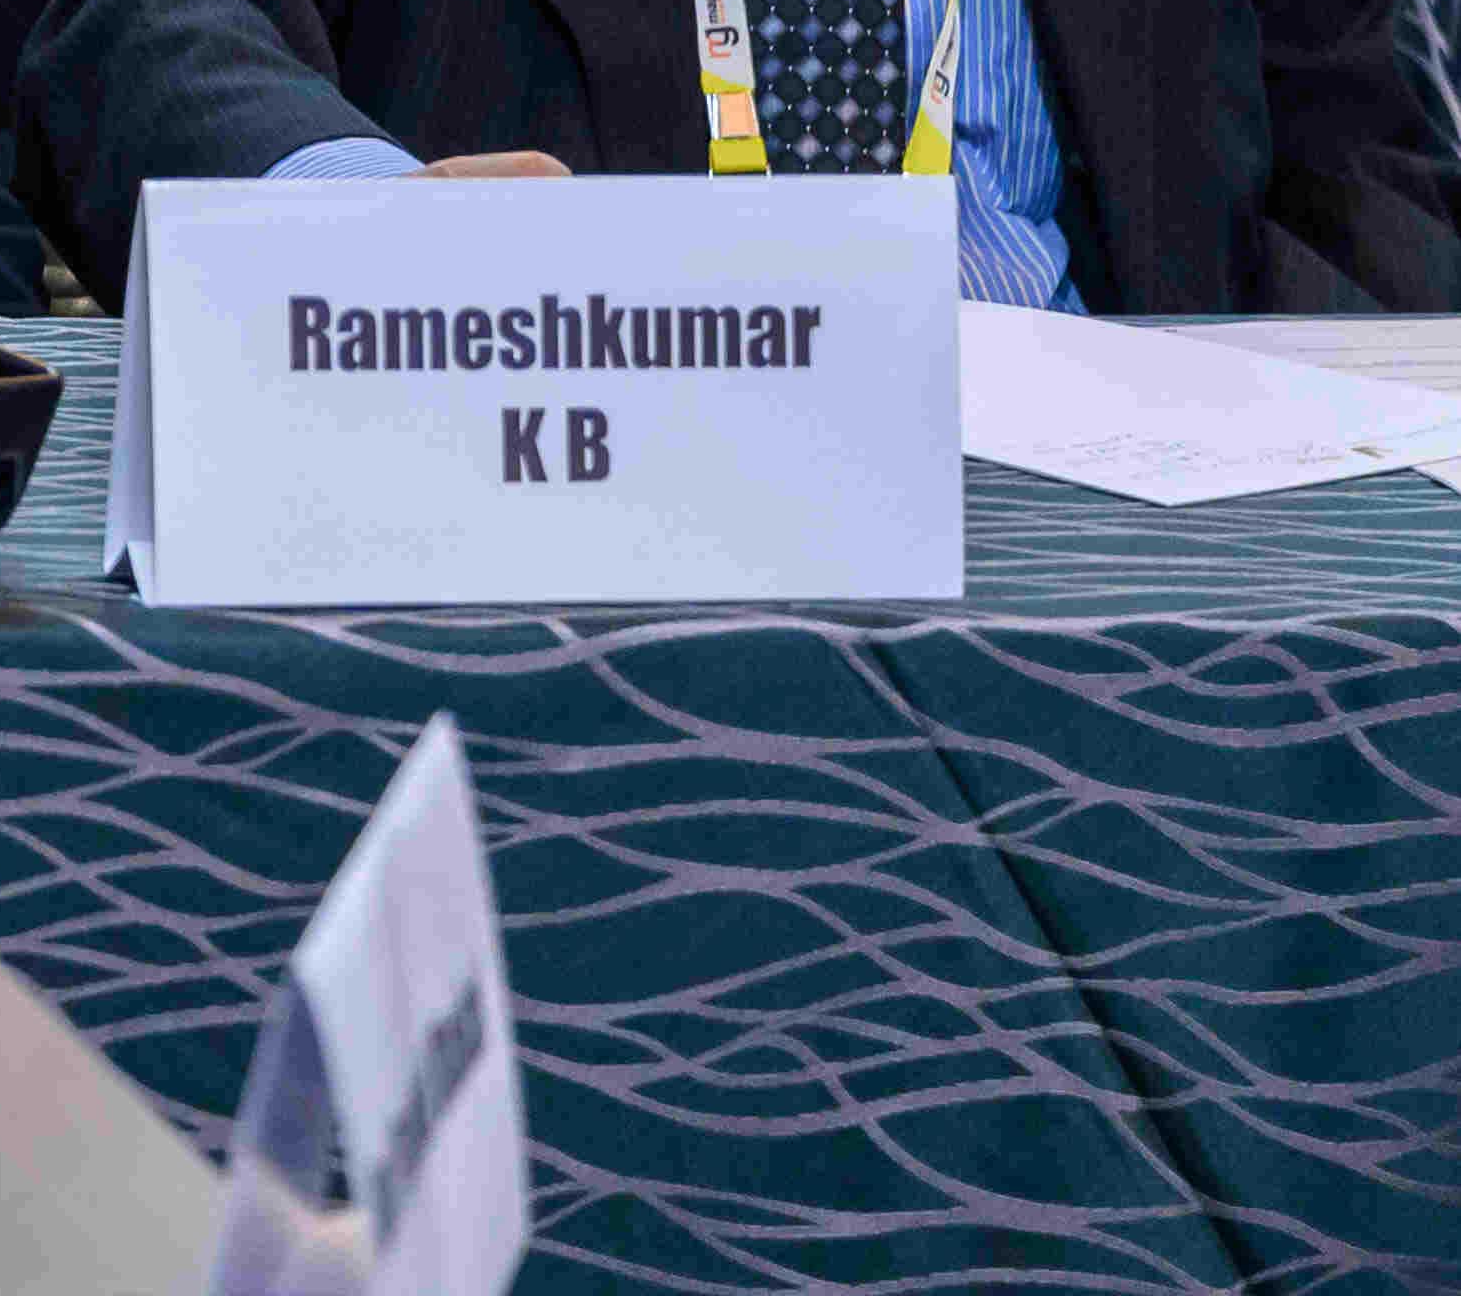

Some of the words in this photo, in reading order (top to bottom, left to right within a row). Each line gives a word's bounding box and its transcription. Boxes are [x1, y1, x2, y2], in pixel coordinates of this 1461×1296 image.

[288, 294, 821, 371] Rameshkumar
[501, 407, 548, 483] K
[566, 407, 611, 483] B
